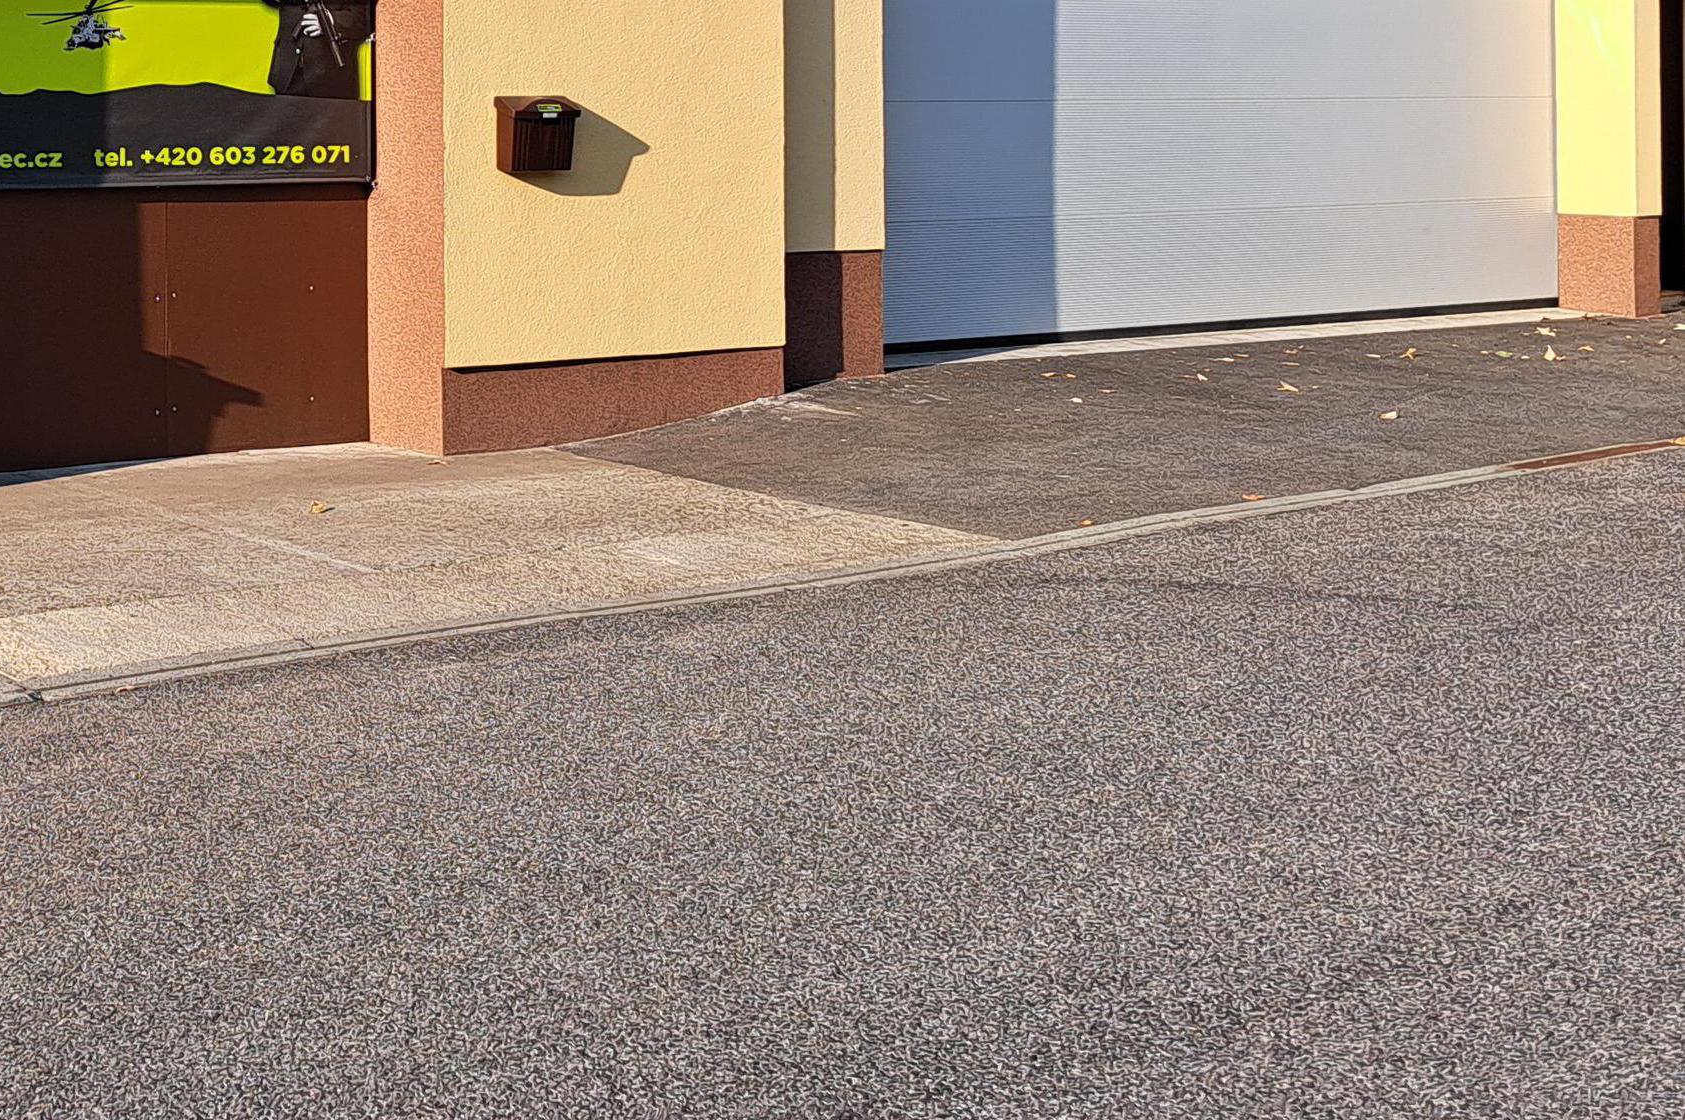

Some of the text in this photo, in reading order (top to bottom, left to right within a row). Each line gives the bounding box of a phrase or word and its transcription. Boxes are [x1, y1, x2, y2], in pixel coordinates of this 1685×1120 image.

[94, 145, 350, 167] tel. +420 603 276 071
